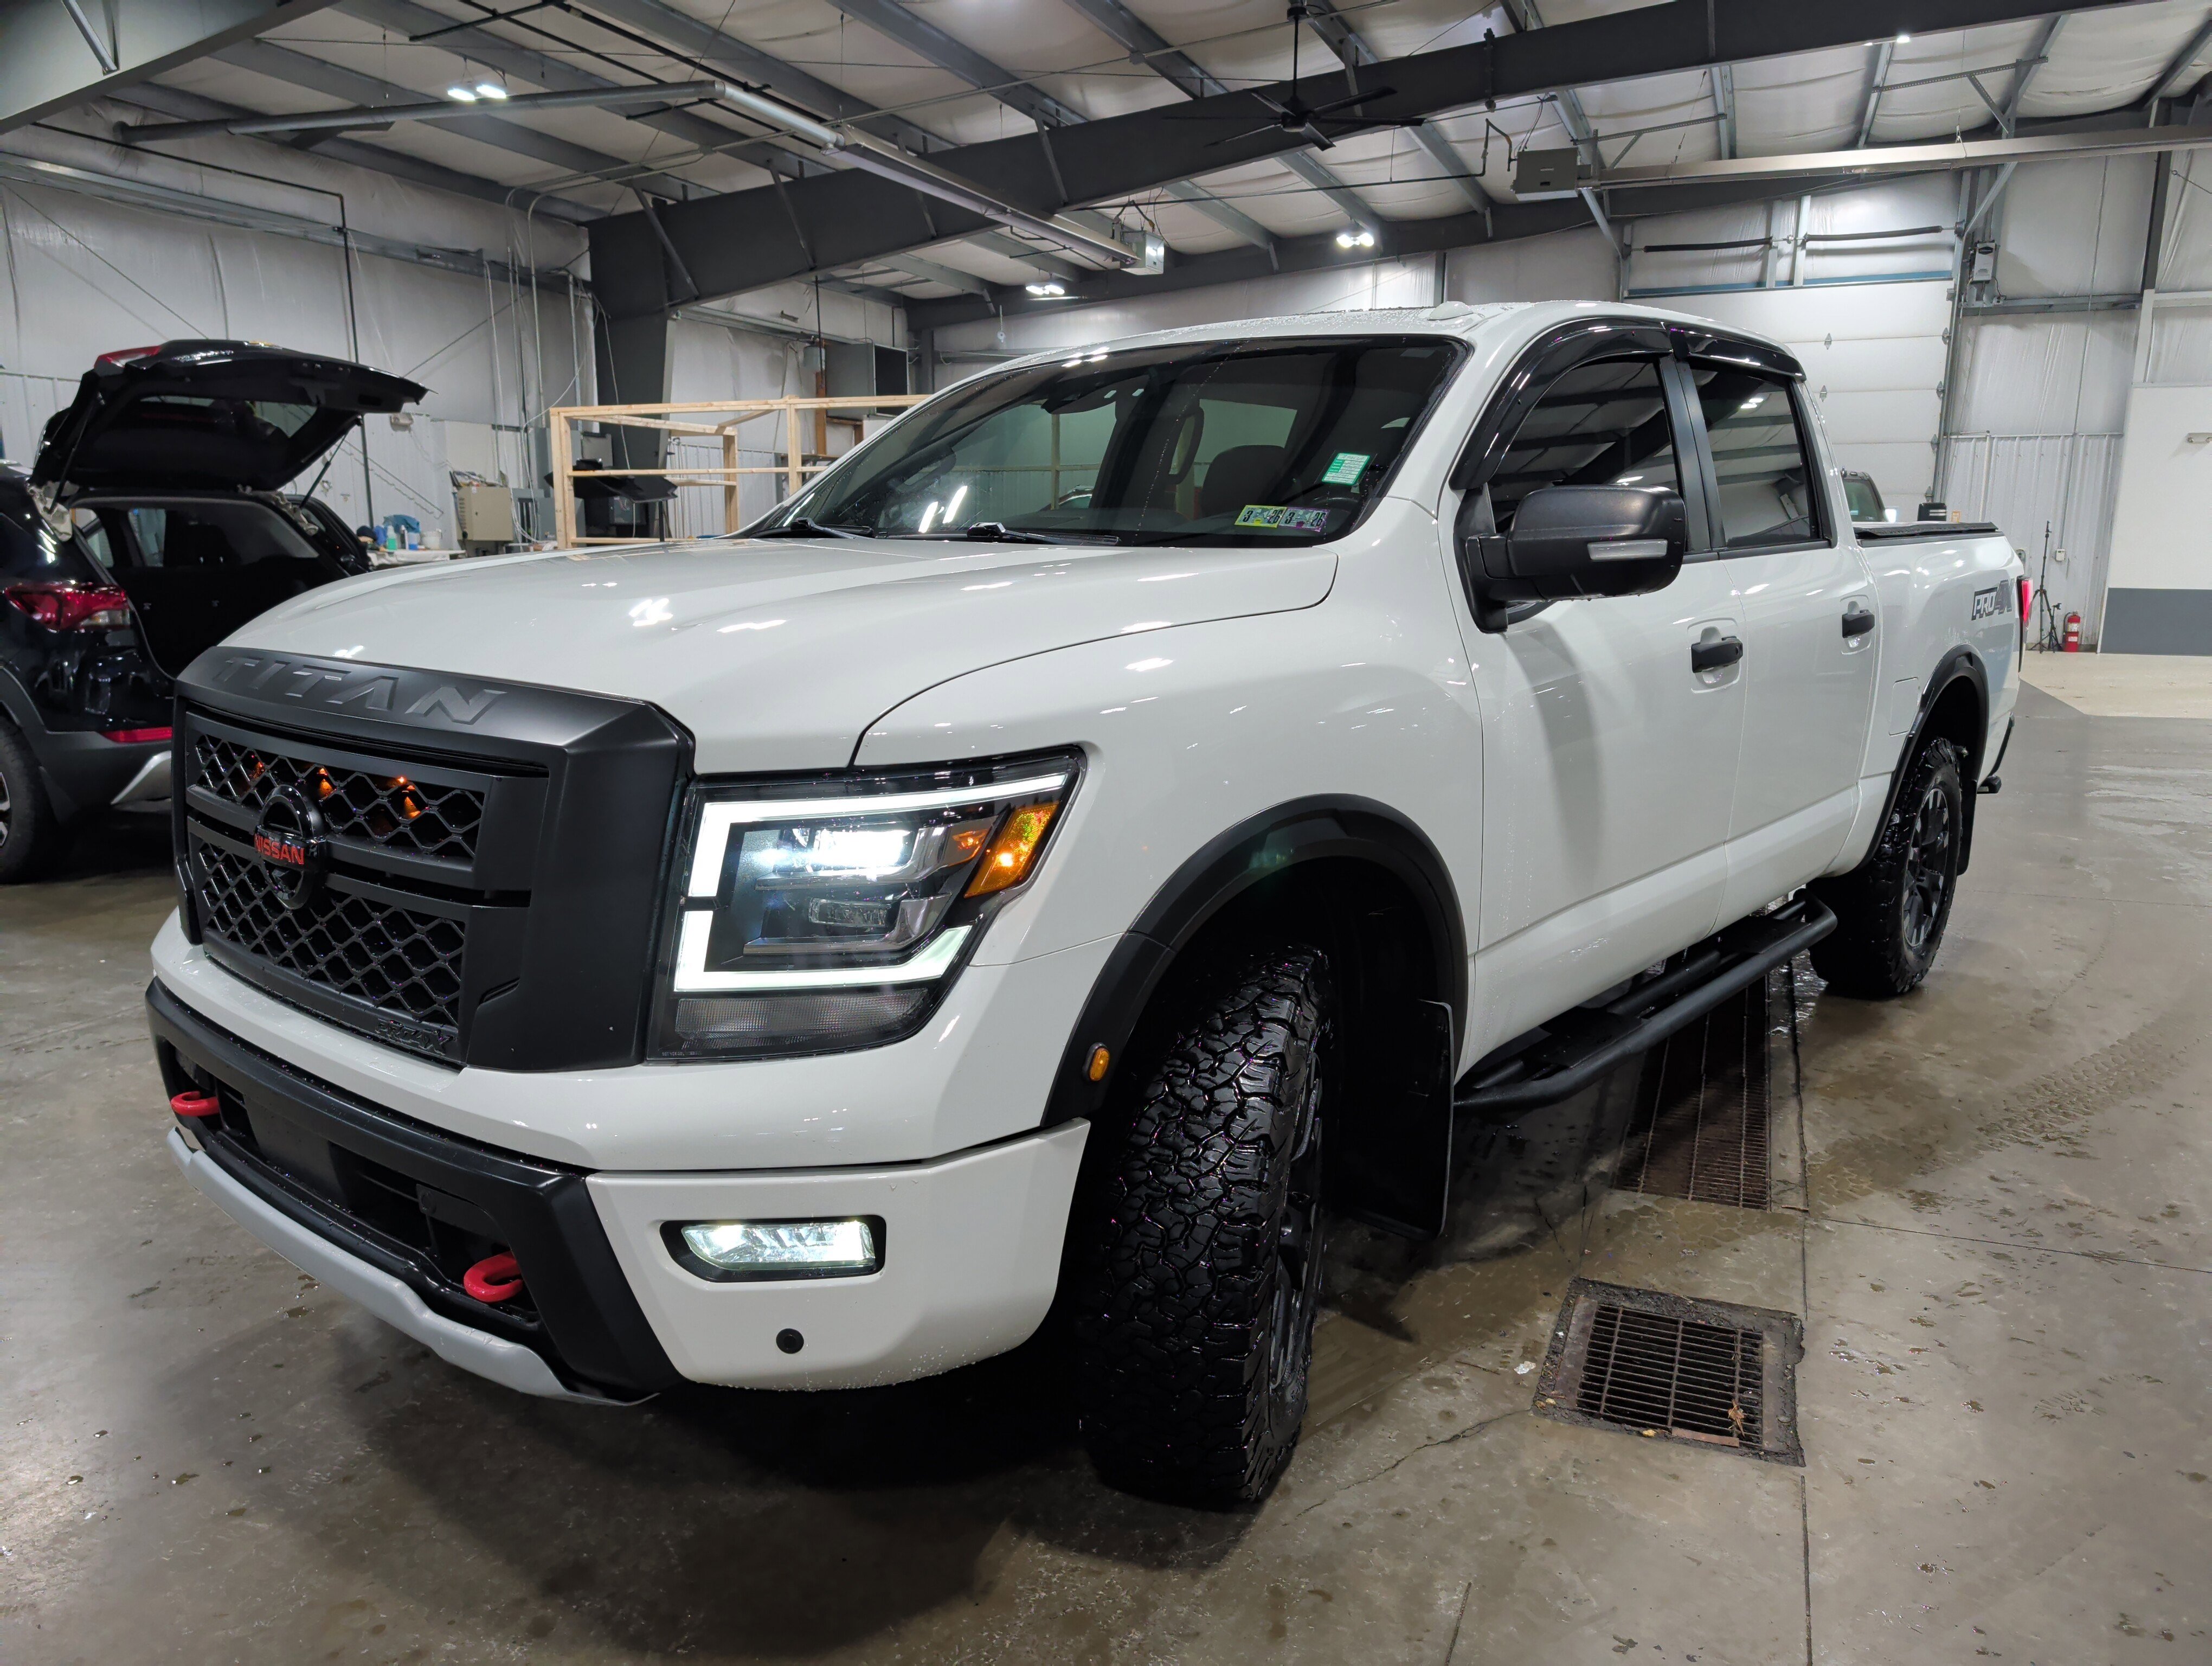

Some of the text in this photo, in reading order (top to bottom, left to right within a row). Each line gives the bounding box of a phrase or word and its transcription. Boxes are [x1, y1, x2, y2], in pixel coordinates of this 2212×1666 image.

[1243, 510, 1284, 524] 3 26
[1284, 512, 1326, 527] 3 26
[211, 656, 506, 725] TITAN
[254, 834, 305, 865] NISSAN
